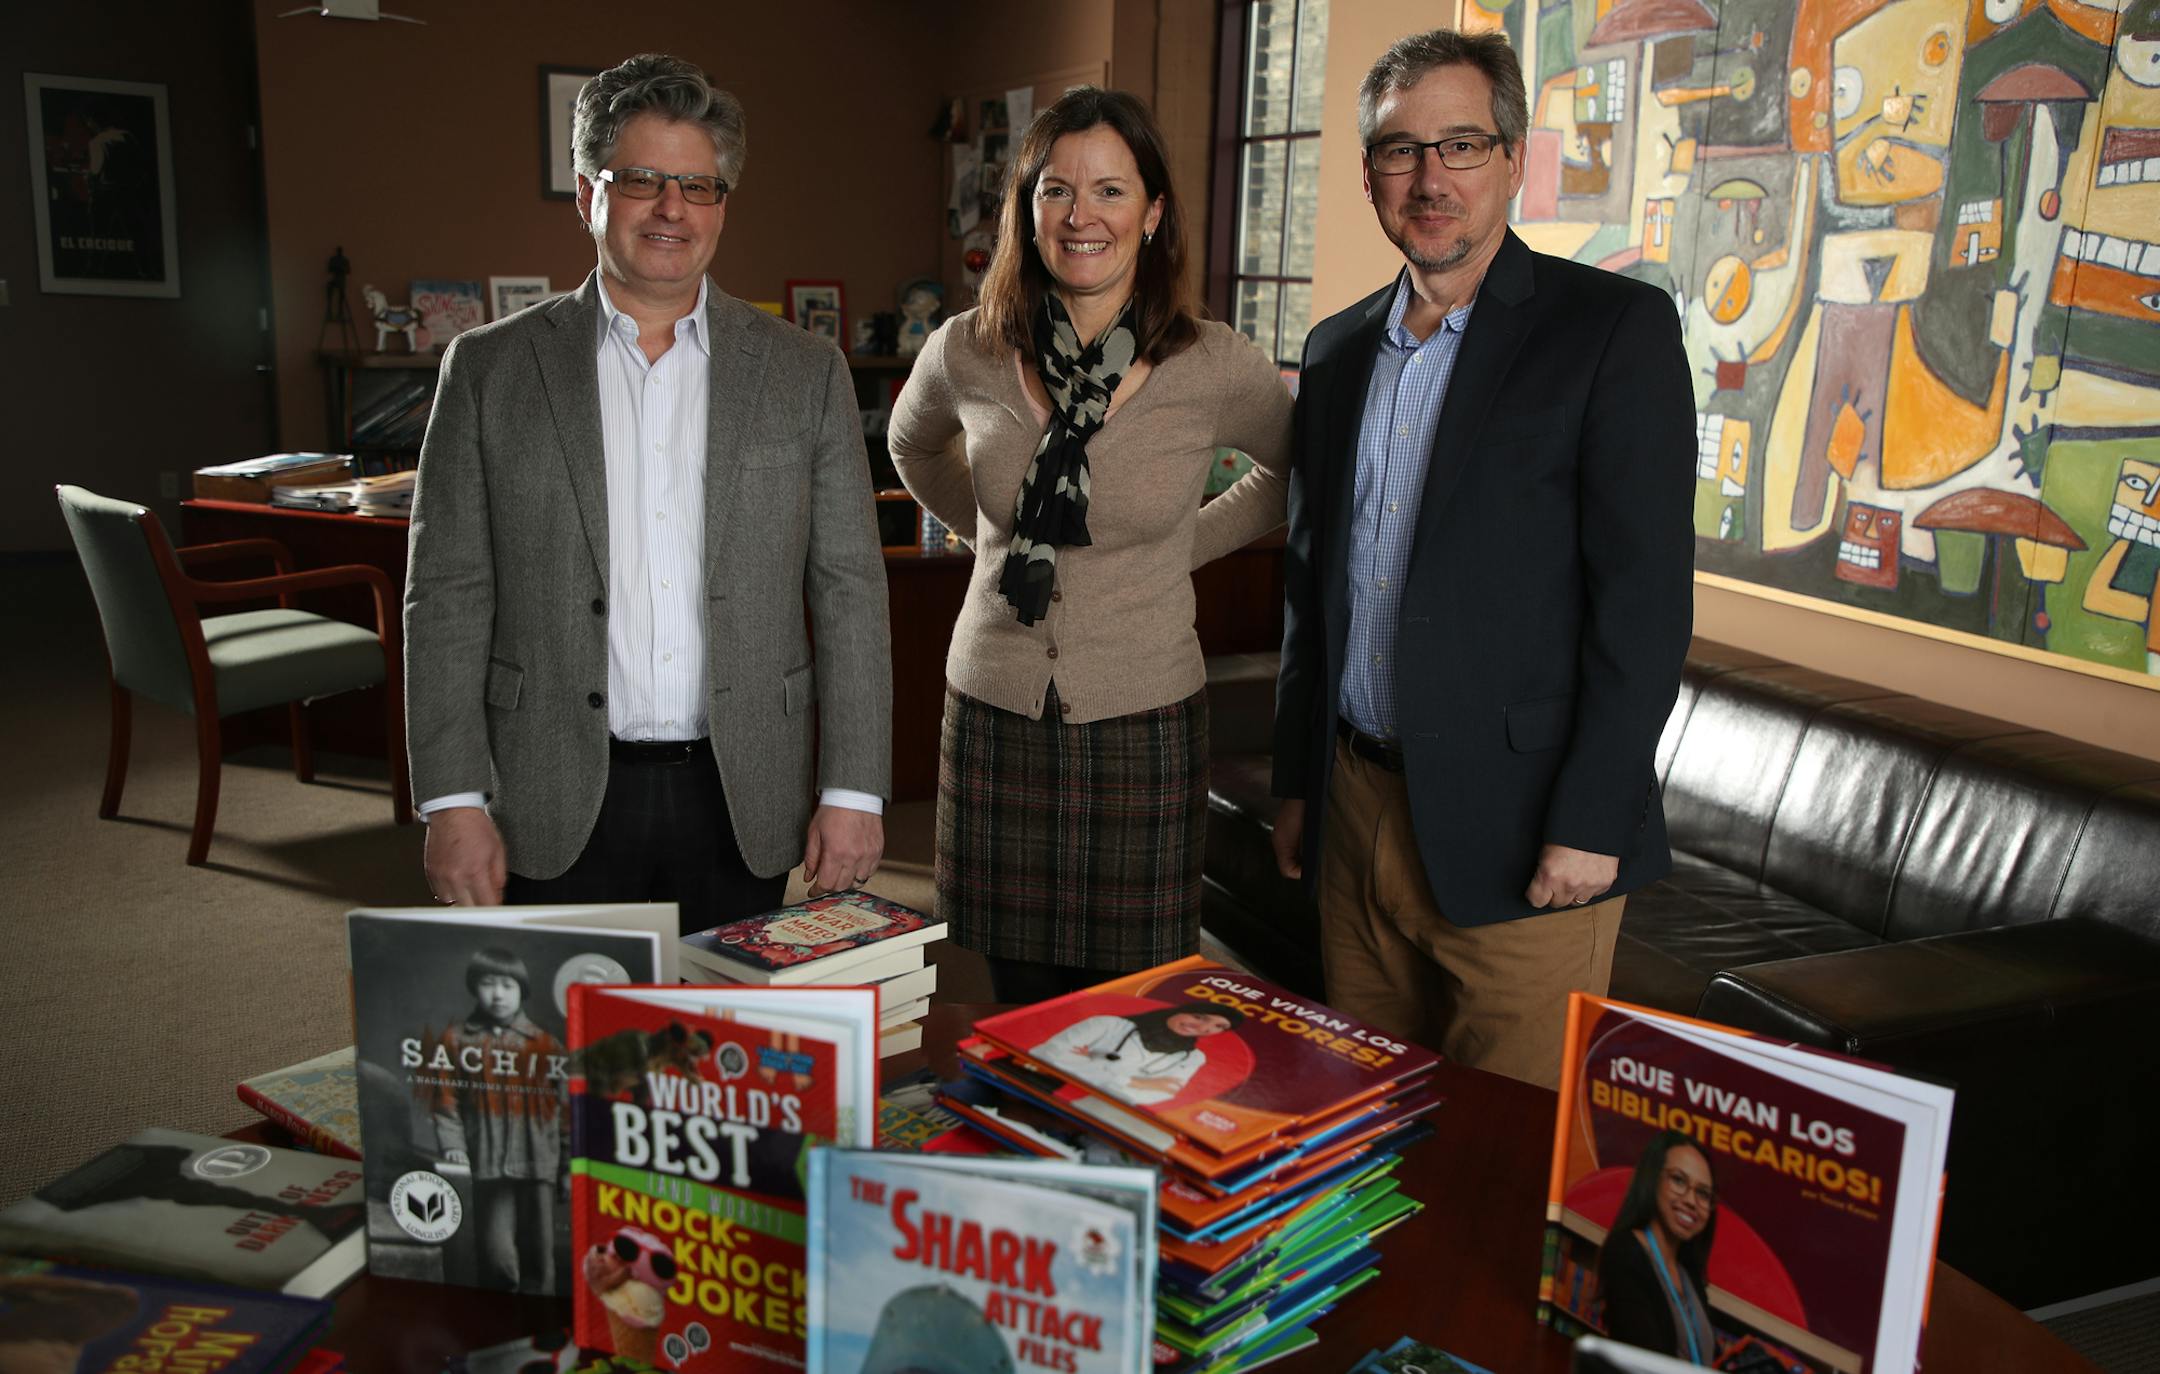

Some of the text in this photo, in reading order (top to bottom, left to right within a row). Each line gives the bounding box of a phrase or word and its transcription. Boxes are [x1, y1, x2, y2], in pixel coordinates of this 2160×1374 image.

[787, 918, 837, 939] MATEO
[813, 913, 855, 931] WAR
[1184, 984, 1395, 1069] DOCTORES!
[1200, 975, 1409, 1055] ¡QUE VIVAN LOS
[646, 1072, 802, 1134] WORLD'S
[1609, 1056, 1856, 1156] ¡QUE VIVAN LOS
[612, 1102, 759, 1189] BEST
[1591, 1079, 1883, 1204] BIBLIOTECARIOS!
[225, 1184, 309, 1237] OUT OF
[598, 1183, 751, 1250] KNOCK-
[849, 1175, 888, 1207] THE
[890, 1188, 1058, 1299] SHARK
[983, 1289, 1104, 1352] ATTACK
[1018, 1338, 1079, 1374] FILES
